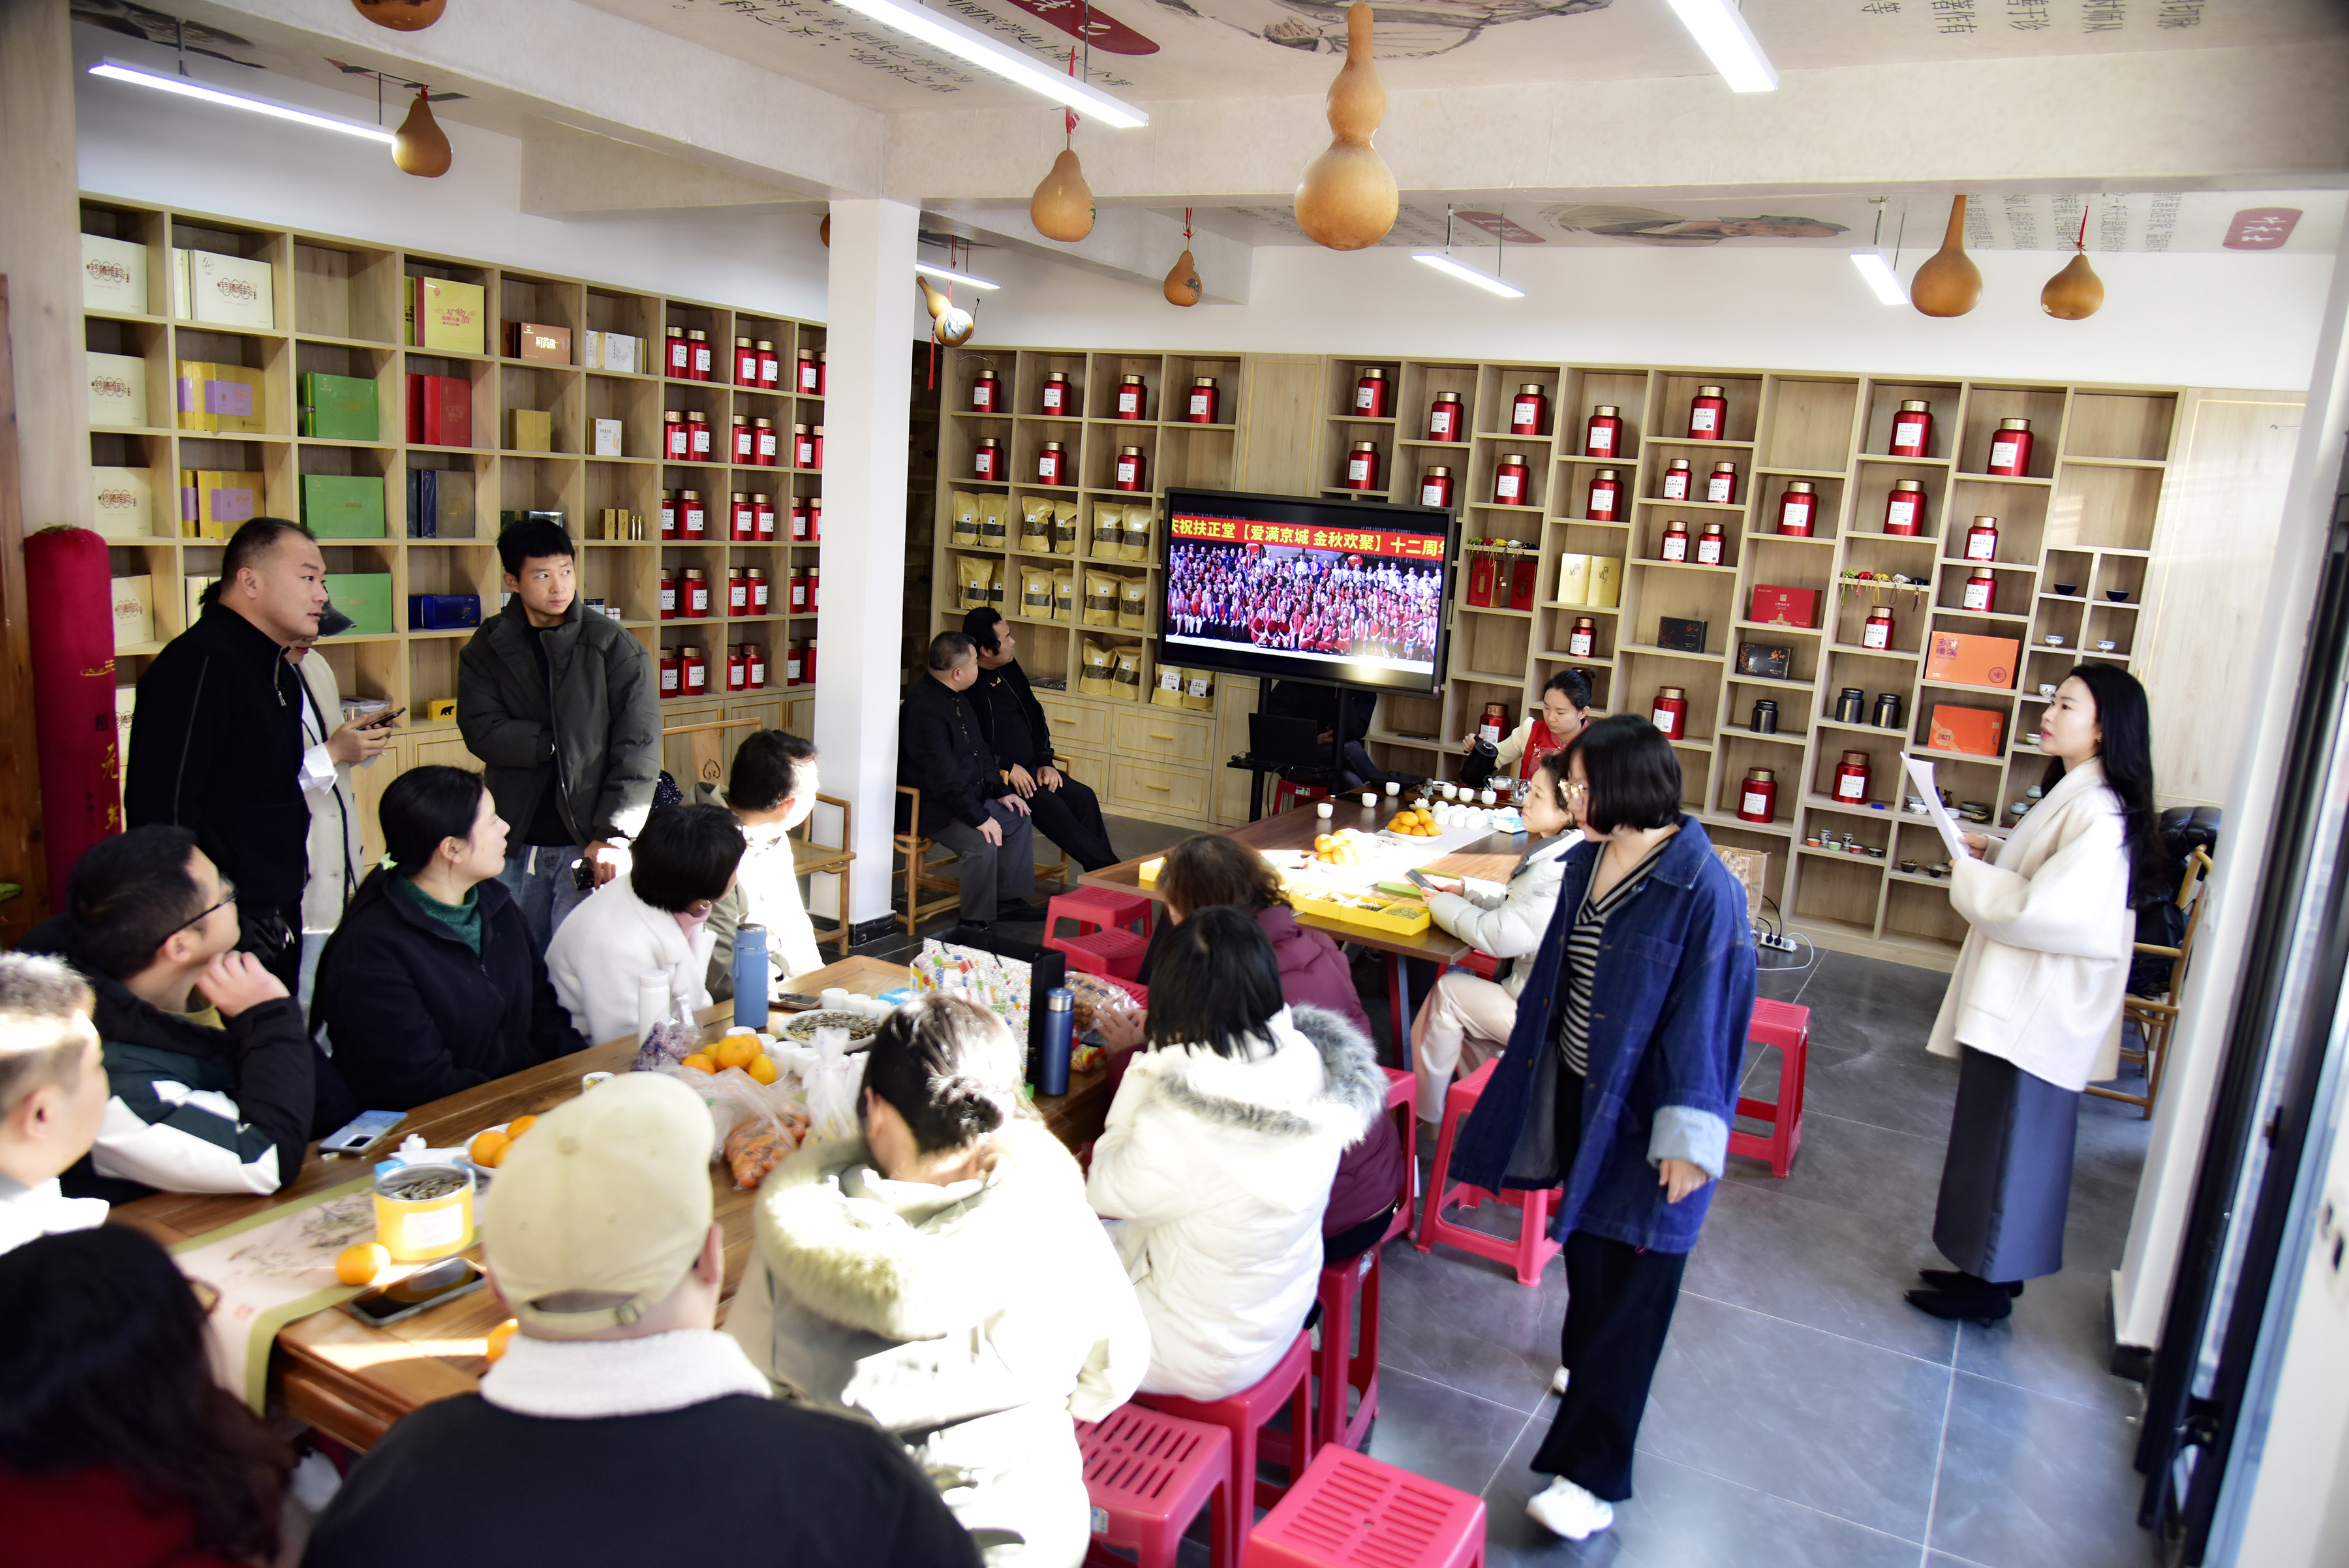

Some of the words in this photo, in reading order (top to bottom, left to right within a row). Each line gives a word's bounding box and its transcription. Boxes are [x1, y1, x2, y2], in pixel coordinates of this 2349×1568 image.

[2156, 0, 2204, 29] 切脉
[1313, 530, 1381, 552] 金秋欢聚】
